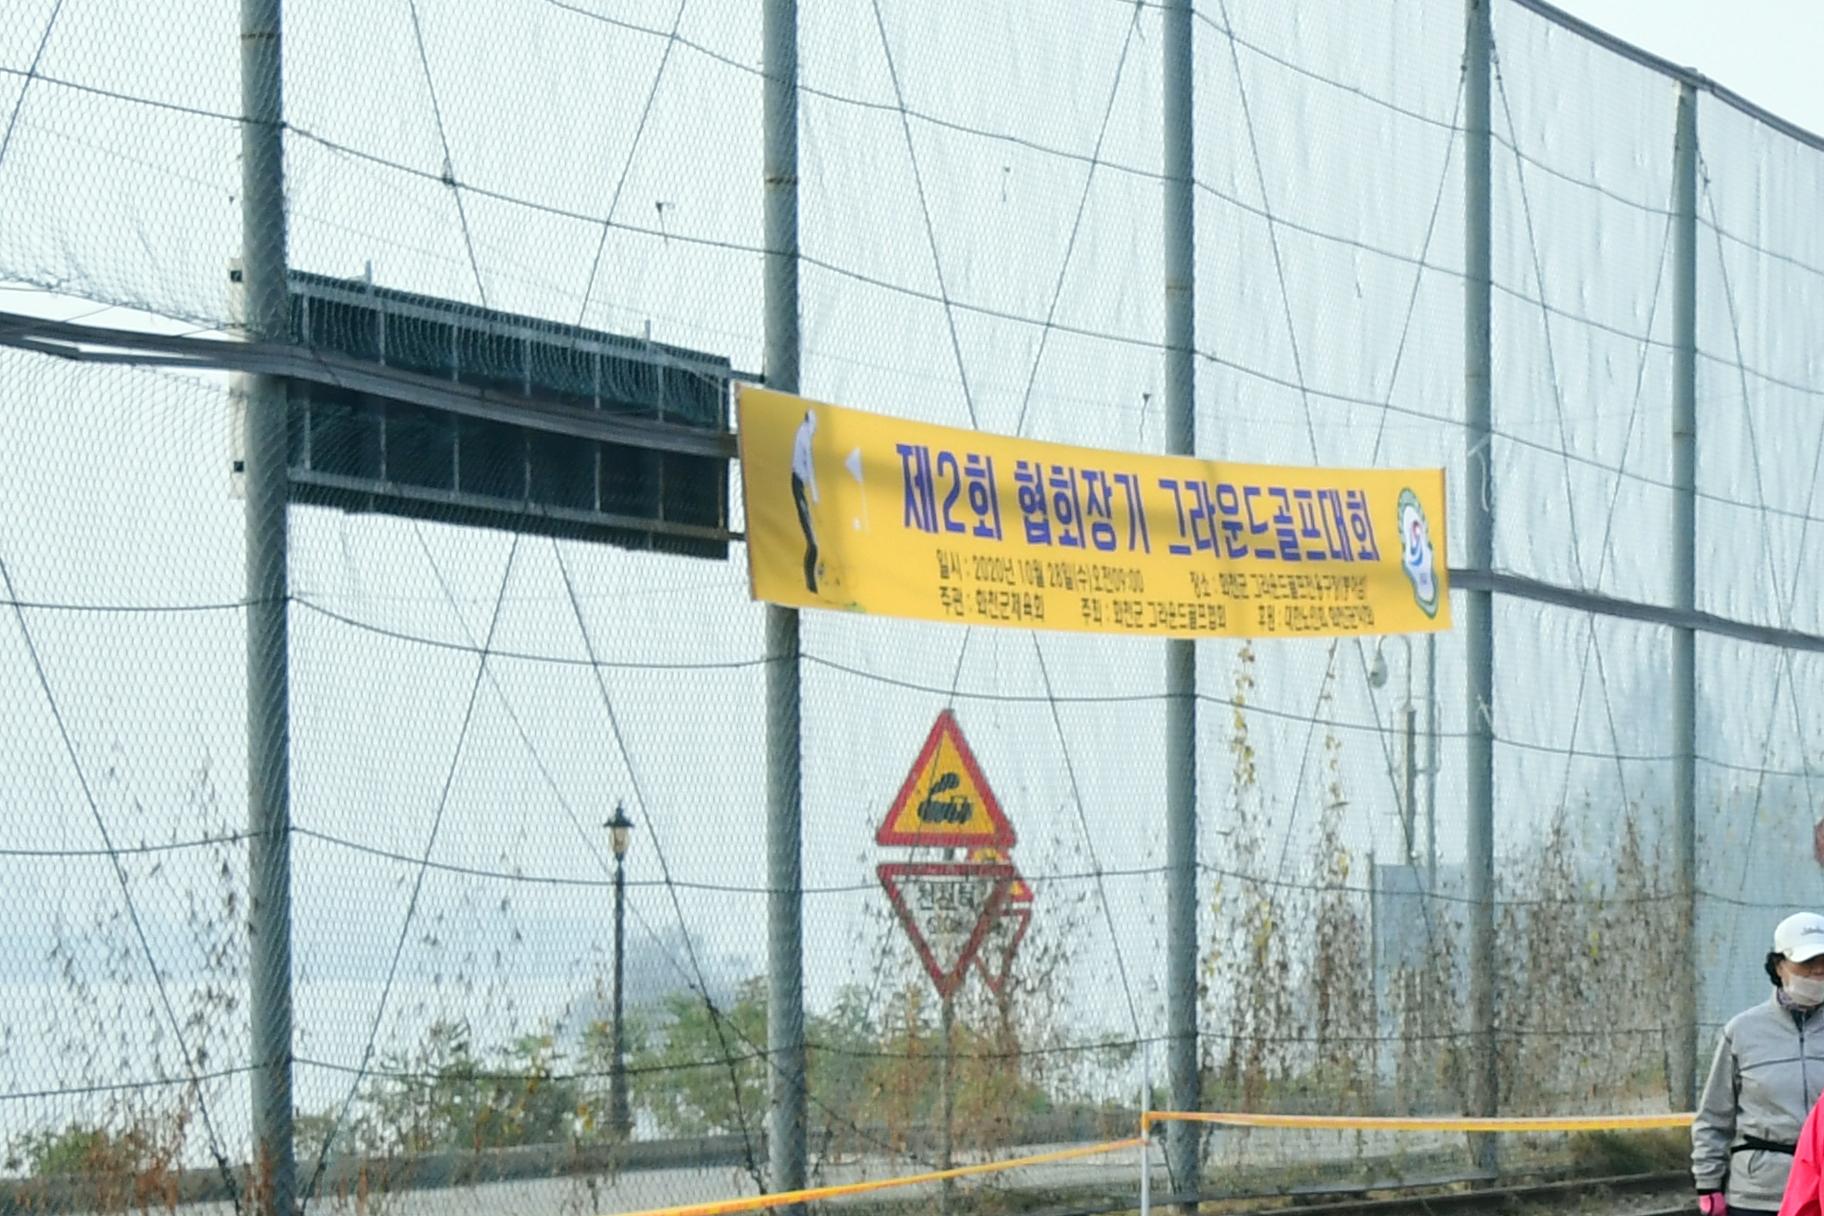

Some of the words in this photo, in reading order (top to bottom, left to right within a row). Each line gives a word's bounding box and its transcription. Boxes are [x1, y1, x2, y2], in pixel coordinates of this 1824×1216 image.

[896, 443, 1003, 541] 제2회
[1014, 460, 1150, 555] 협회장기
[1157, 478, 1380, 562] 그라운드골프대회
[936, 549, 963, 582] 일시
[1190, 571, 1212, 599] 장소
[939, 586, 964, 617] 주관
